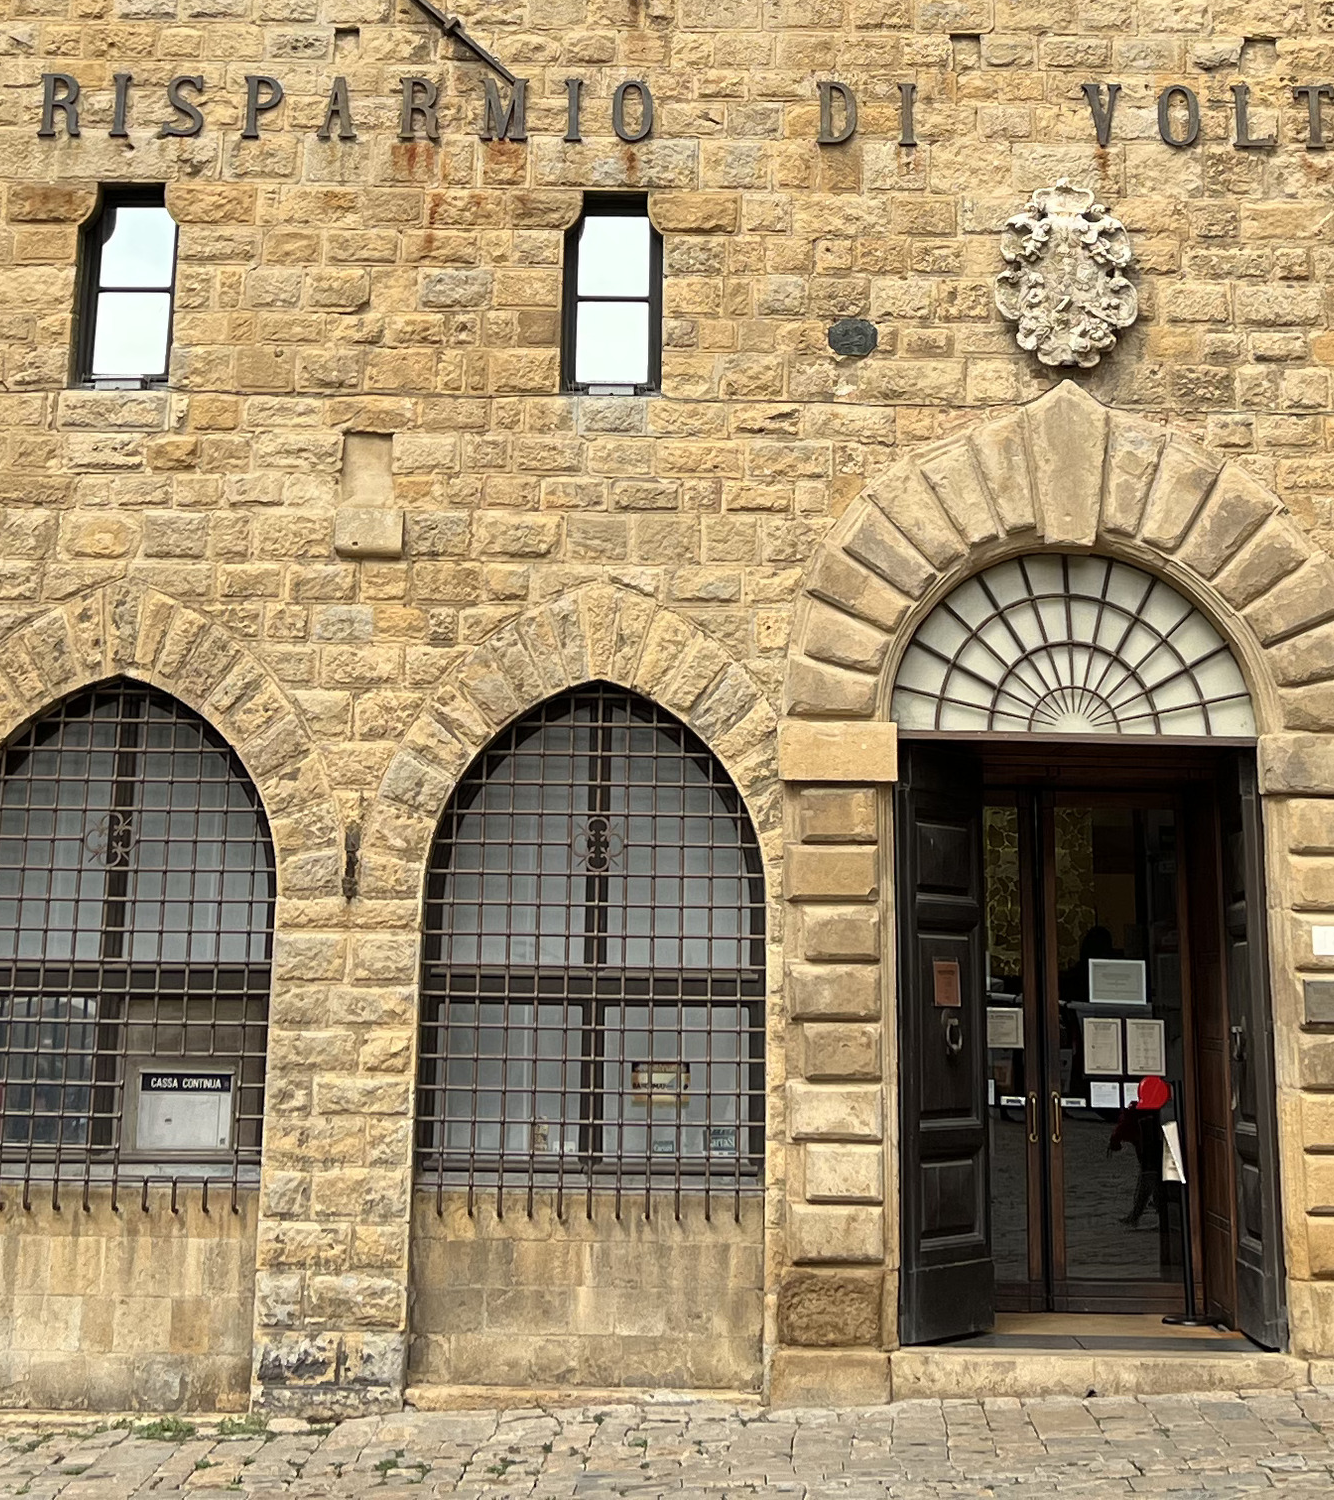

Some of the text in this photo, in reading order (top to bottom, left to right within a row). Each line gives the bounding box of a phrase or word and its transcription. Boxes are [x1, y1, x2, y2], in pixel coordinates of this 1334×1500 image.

[37, 73, 655, 143] RISPARMIO
[815, 79, 919, 148] DI
[150, 1077, 222, 1089] CASSA CONTINUA
